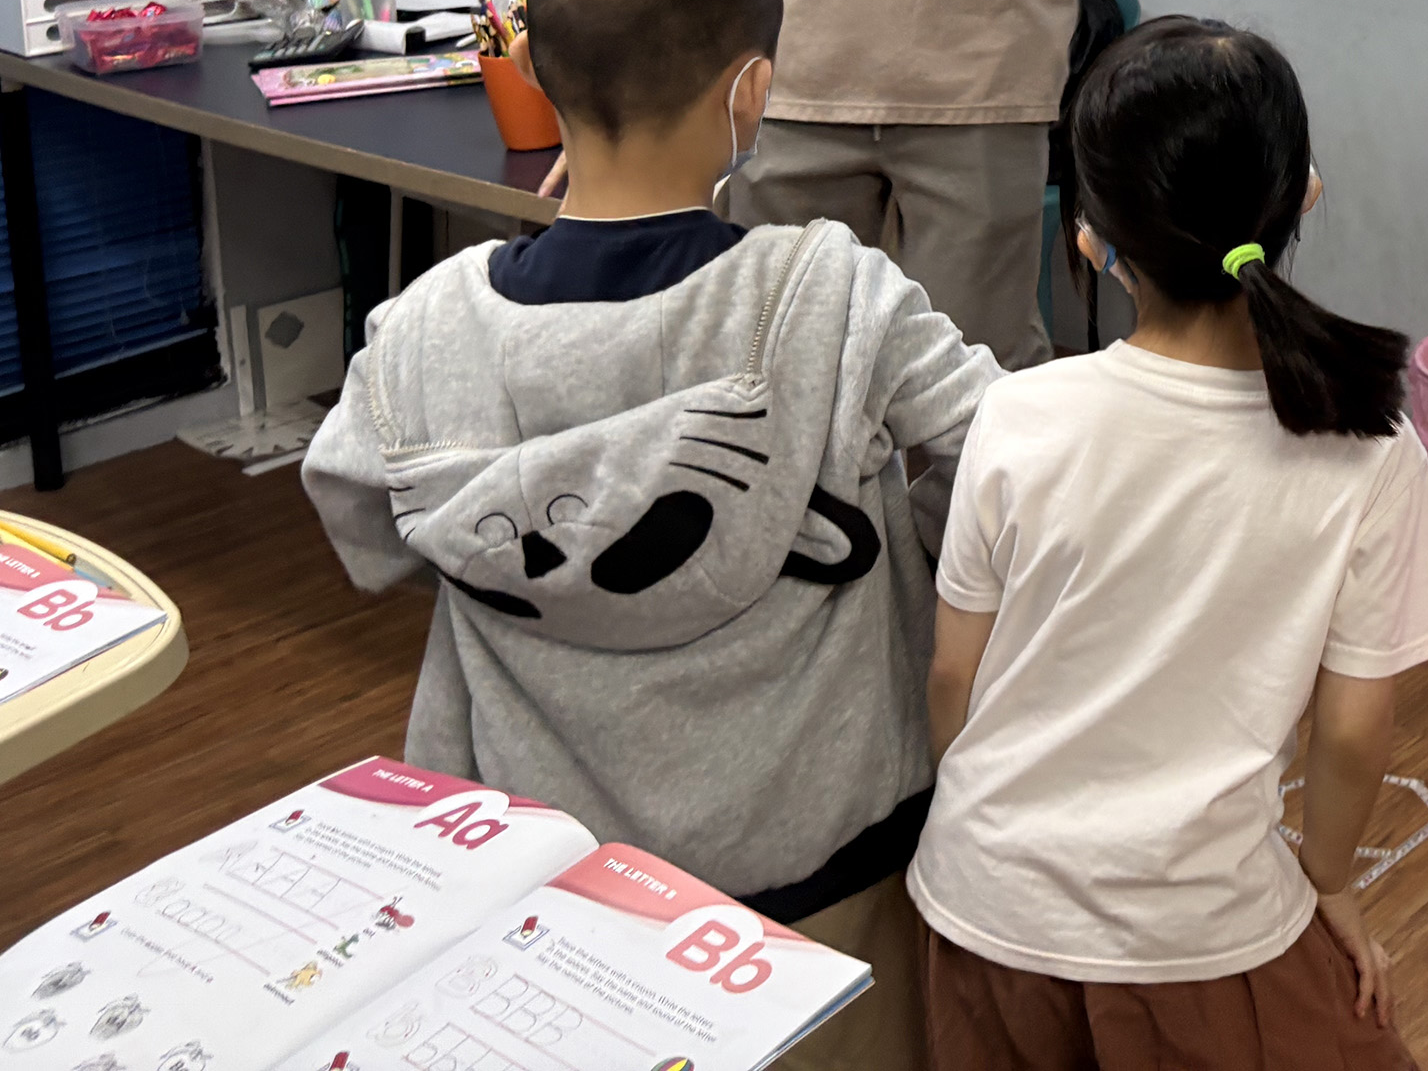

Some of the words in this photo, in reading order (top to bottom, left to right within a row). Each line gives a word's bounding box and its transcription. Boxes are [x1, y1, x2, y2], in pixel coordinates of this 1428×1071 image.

[17, 588, 96, 631] Bb
[413, 801, 510, 850] Aa
[603, 857, 628, 874] THE
[624, 867, 669, 895] LETTER
[665, 919, 773, 994] Bb
